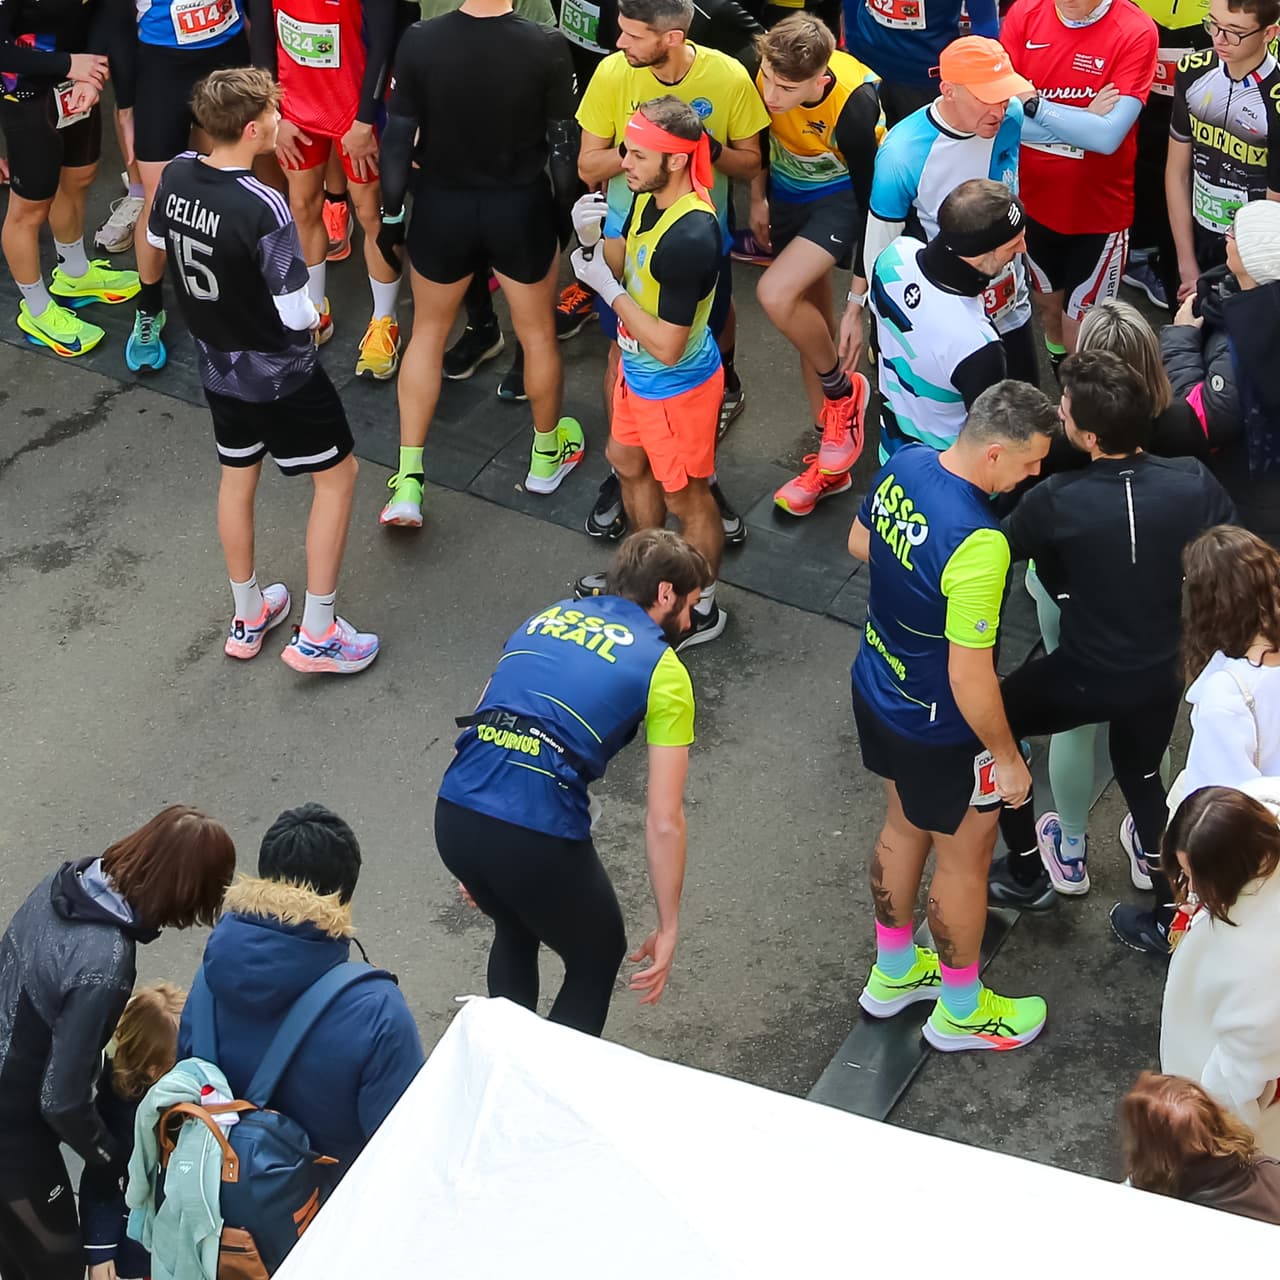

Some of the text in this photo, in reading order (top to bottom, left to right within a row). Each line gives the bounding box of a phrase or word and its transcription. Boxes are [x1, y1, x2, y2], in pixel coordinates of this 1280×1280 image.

[182, 7, 220, 29] 114
[564, 5, 591, 33] 531
[283, 28, 314, 53] 524
[1177, 51, 1213, 72] USJ
[1195, 193, 1222, 218] 525
[168, 228, 220, 301] 15
[877, 473, 929, 546] ASSO
[871, 492, 914, 572] TRAIL
[526, 618, 617, 663] TRAIL
[534, 606, 635, 646] ASSO
